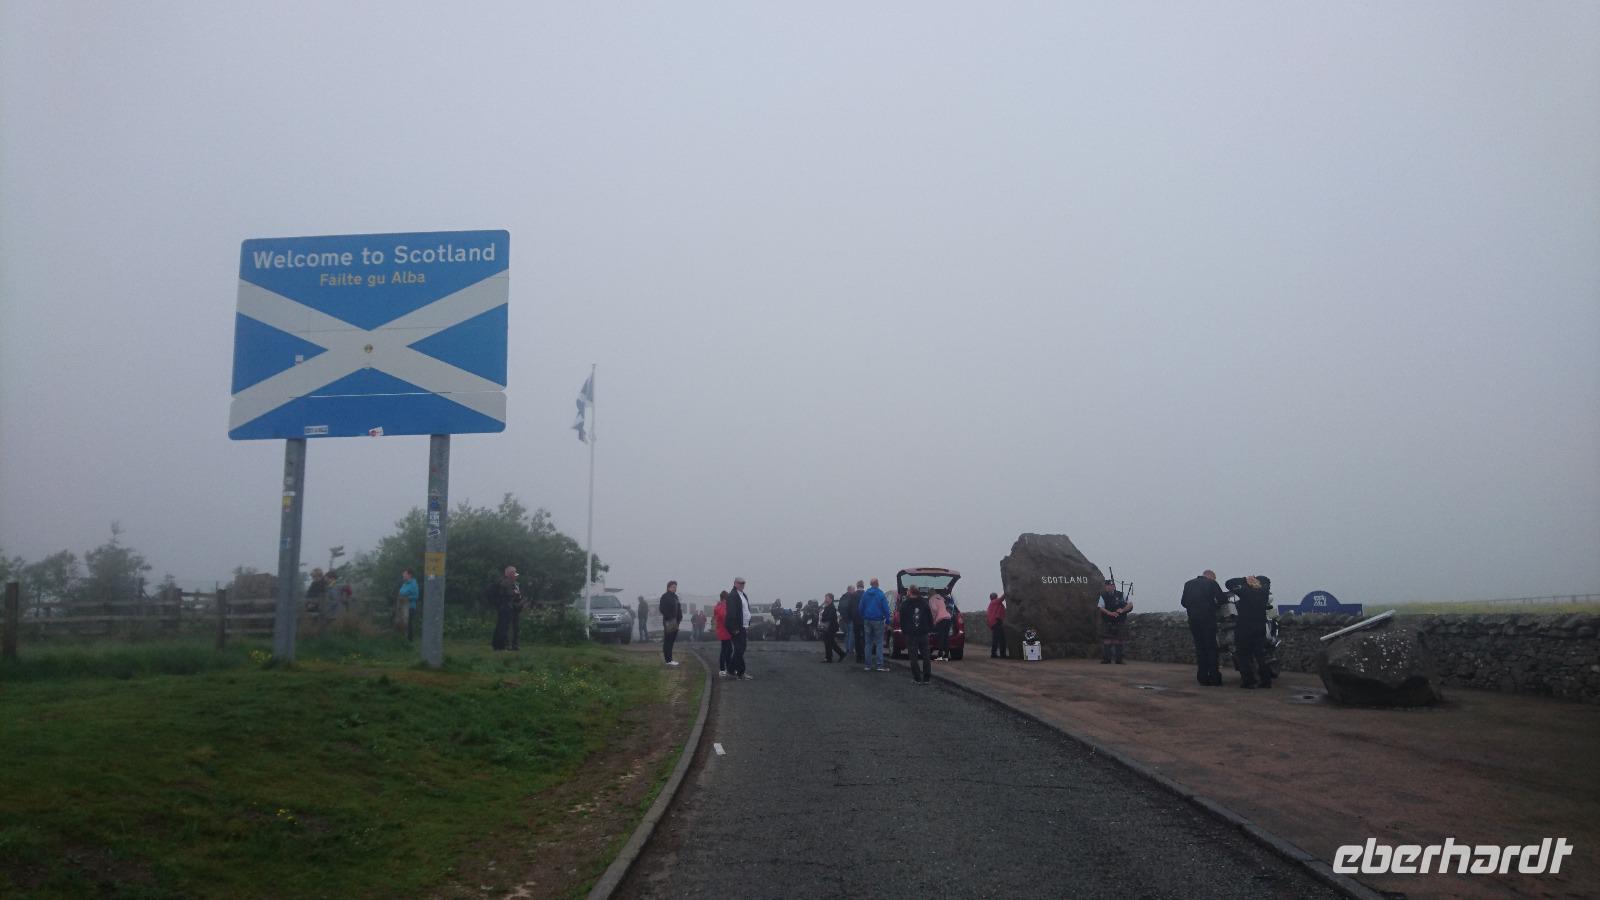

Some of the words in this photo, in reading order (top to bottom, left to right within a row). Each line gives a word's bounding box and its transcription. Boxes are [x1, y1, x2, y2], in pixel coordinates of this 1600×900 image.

[253, 250, 353, 269] Welcome
[362, 247, 384, 265] to
[394, 243, 495, 264] Scotland
[367, 274, 385, 287] gu
[391, 271, 425, 284] Alba
[1041, 576, 1088, 584] SCOTLAND
